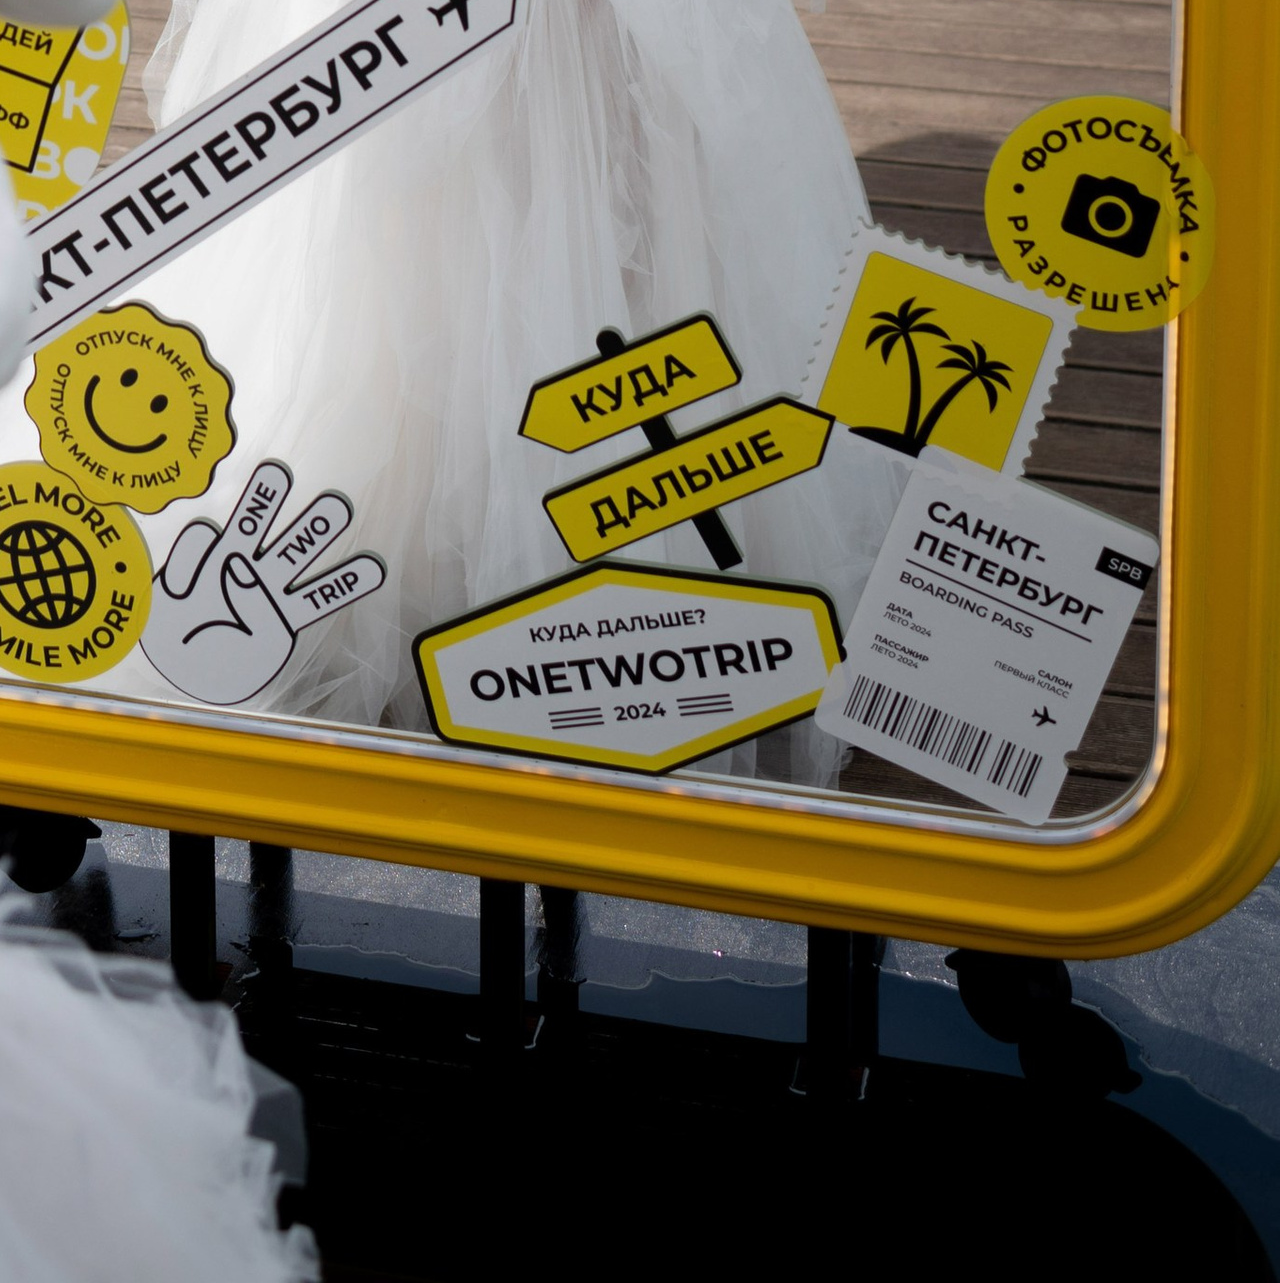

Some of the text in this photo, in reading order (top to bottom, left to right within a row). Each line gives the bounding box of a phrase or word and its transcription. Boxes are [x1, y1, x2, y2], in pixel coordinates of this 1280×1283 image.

[27, 14, 410, 310] КТ-ПЕТЕРБУРГ
[75, 330, 209, 459] ОТПУСК МНЕ К ЛИЦУ
[570, 354, 697, 424] КУДА
[50, 363, 182, 488] ОТПУСК МНЕ К ЛИЦУ
[237, 482, 277, 537] ONE
[589, 429, 783, 539] ДАЛЬШЕ
[34, 482, 122, 549] MORE
[276, 515, 331, 567] TWO
[927, 500, 1046, 564] САНКТ-
[303, 571, 360, 612] TRIP
[913, 530, 1104, 625] ПЕТЕРБУРГ
[1107, 556, 1144, 581] SPB
[67, 589, 135, 665] MORE
[529, 608, 706, 644] КУДА ДАЛЬШЕ?
[883, 610, 932, 638] ЛЕТО 2024
[886, 602, 913, 619] ДАТА
[899, 571, 1035, 639] BOARDING PASS
[469, 637, 793, 702] ONETWOTRIP
[870, 642, 919, 670] ЛЕТО 2024
[874, 633, 929, 663] ПАССАЖИР
[994, 659, 1070, 699] ПЕРВЫЙ КЛАСС
[1037, 669, 1073, 690] САЛОН
[613, 702, 667, 723] 2024
